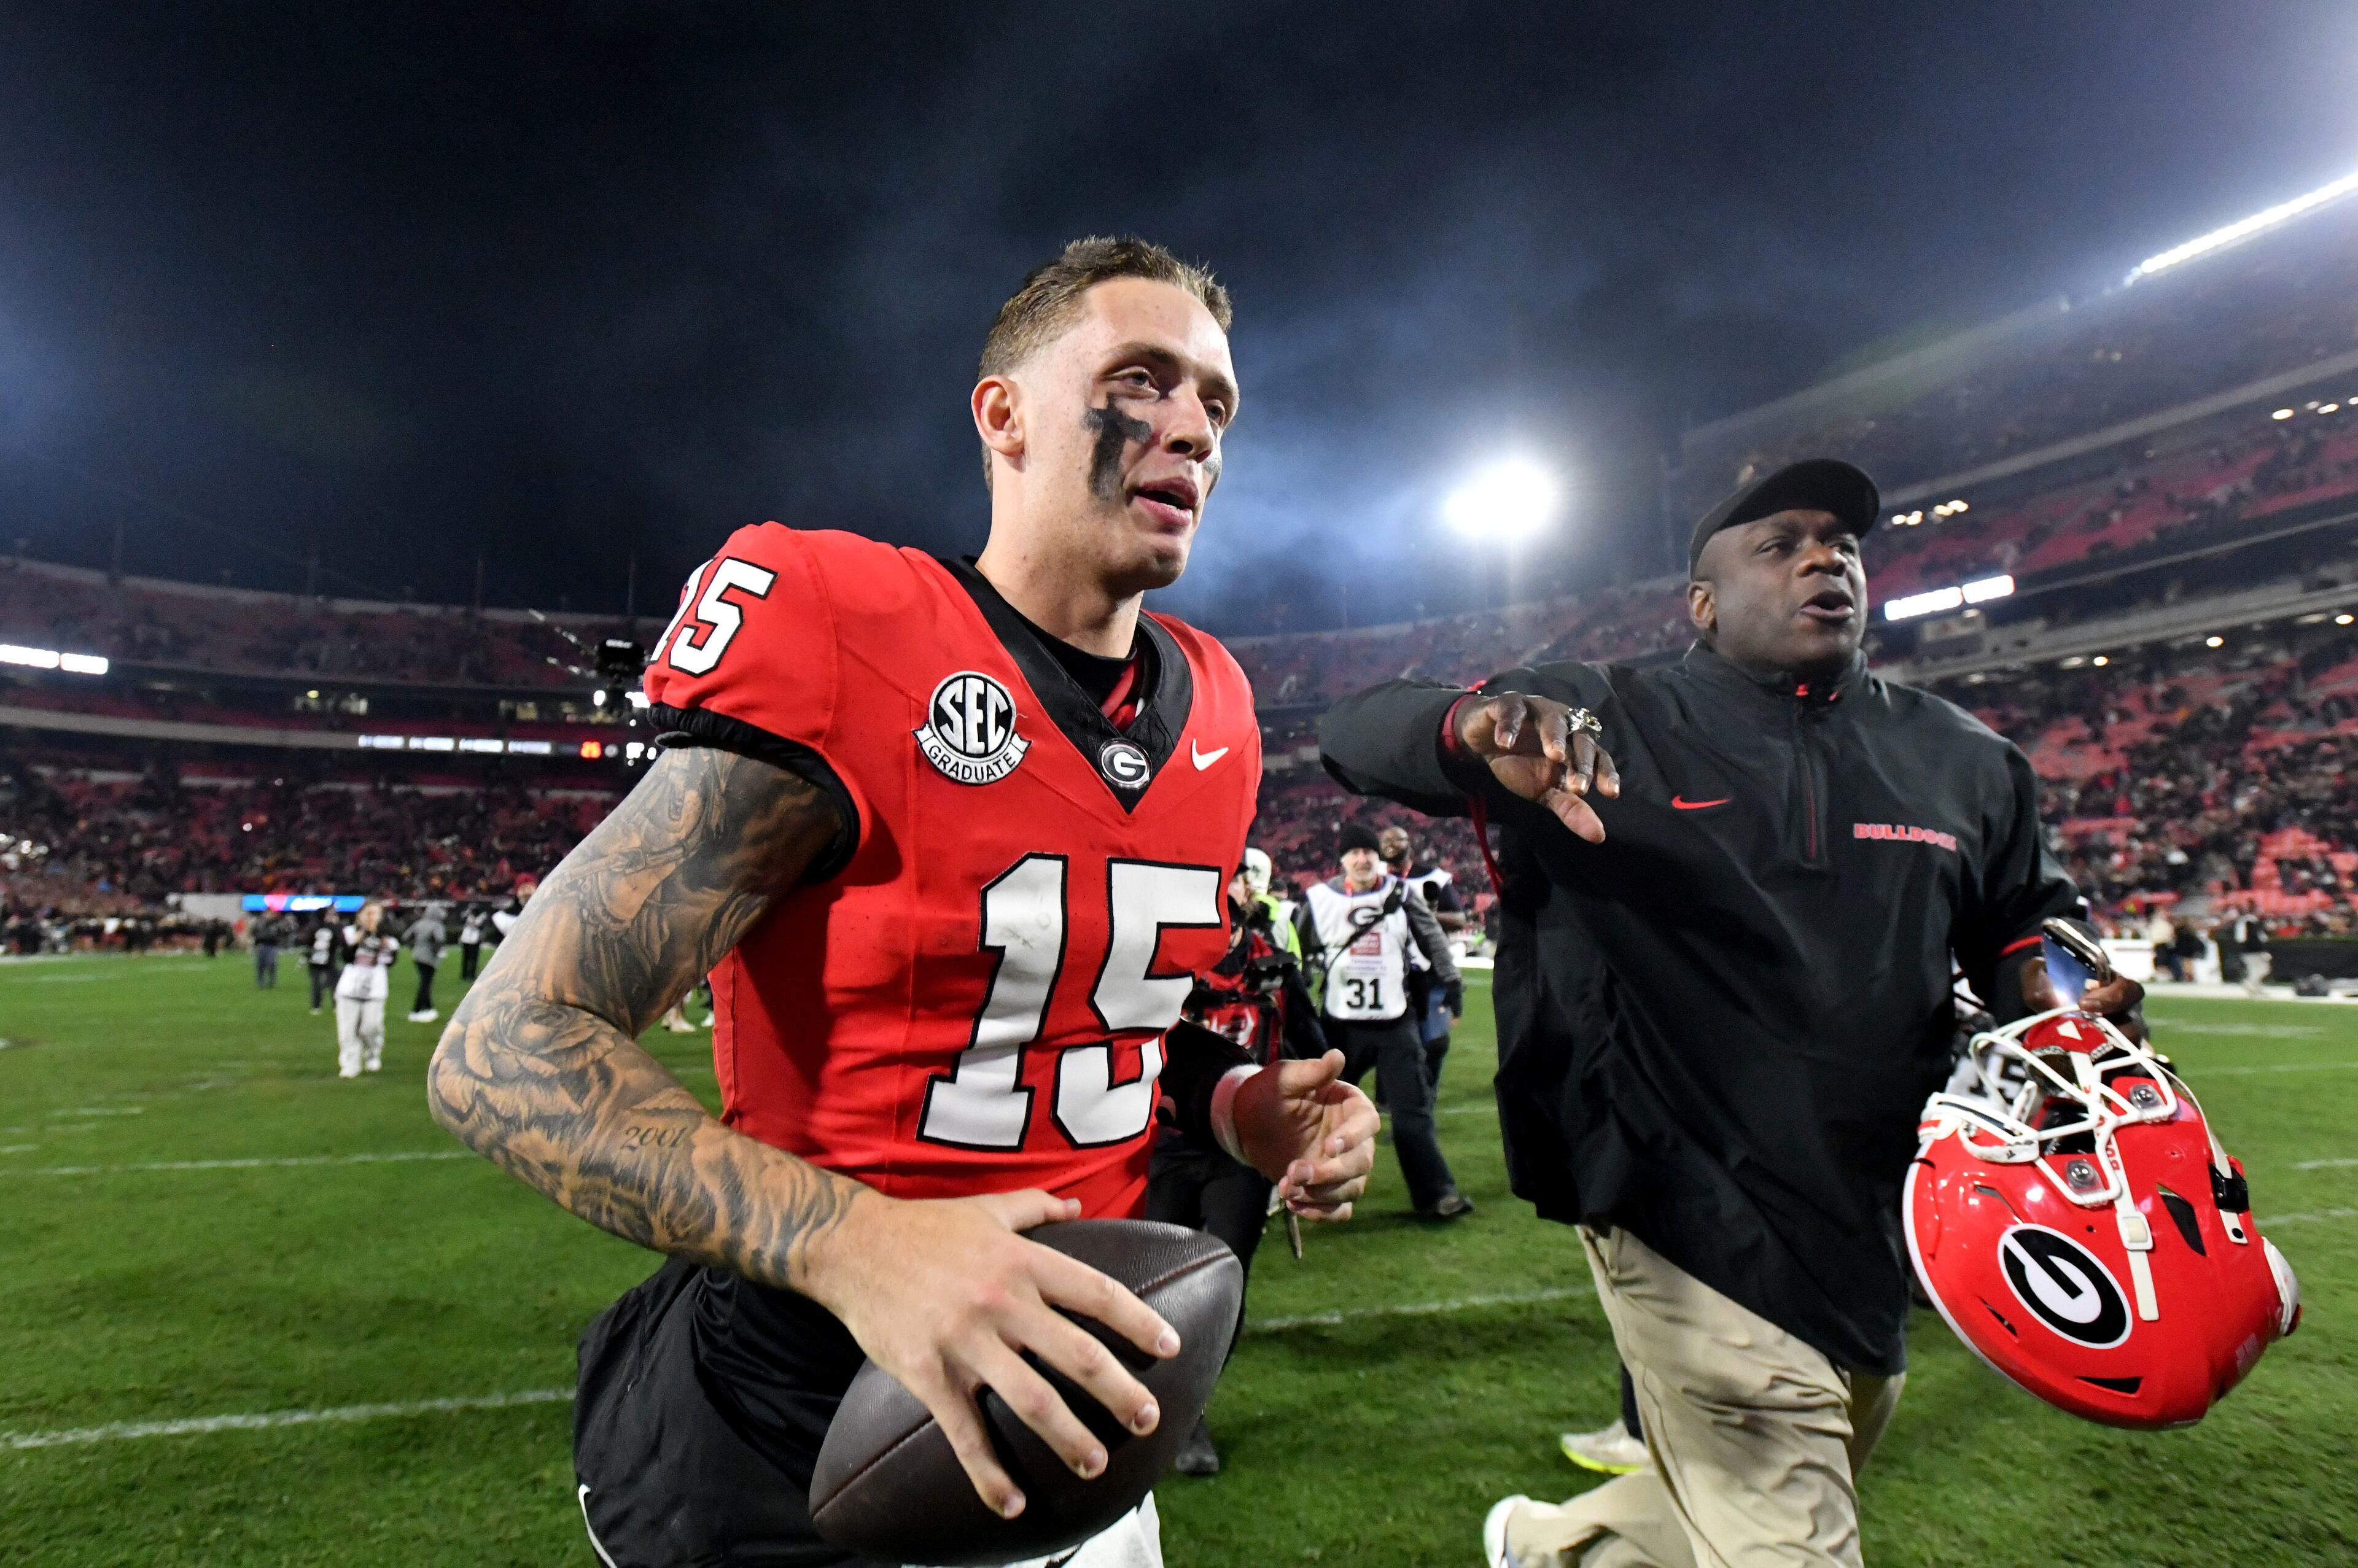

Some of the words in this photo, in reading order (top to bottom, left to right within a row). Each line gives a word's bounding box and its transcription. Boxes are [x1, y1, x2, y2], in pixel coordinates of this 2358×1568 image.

[650, 556, 779, 678] 15
[938, 677, 1008, 755] SEC
[928, 745, 1016, 781] GRADUATE
[1103, 745, 1146, 783] G
[916, 851, 1222, 1152] 15
[1346, 979, 1383, 1009] 31
[619, 1126, 687, 1152] 2001
[2001, 1226, 2129, 1346] G
